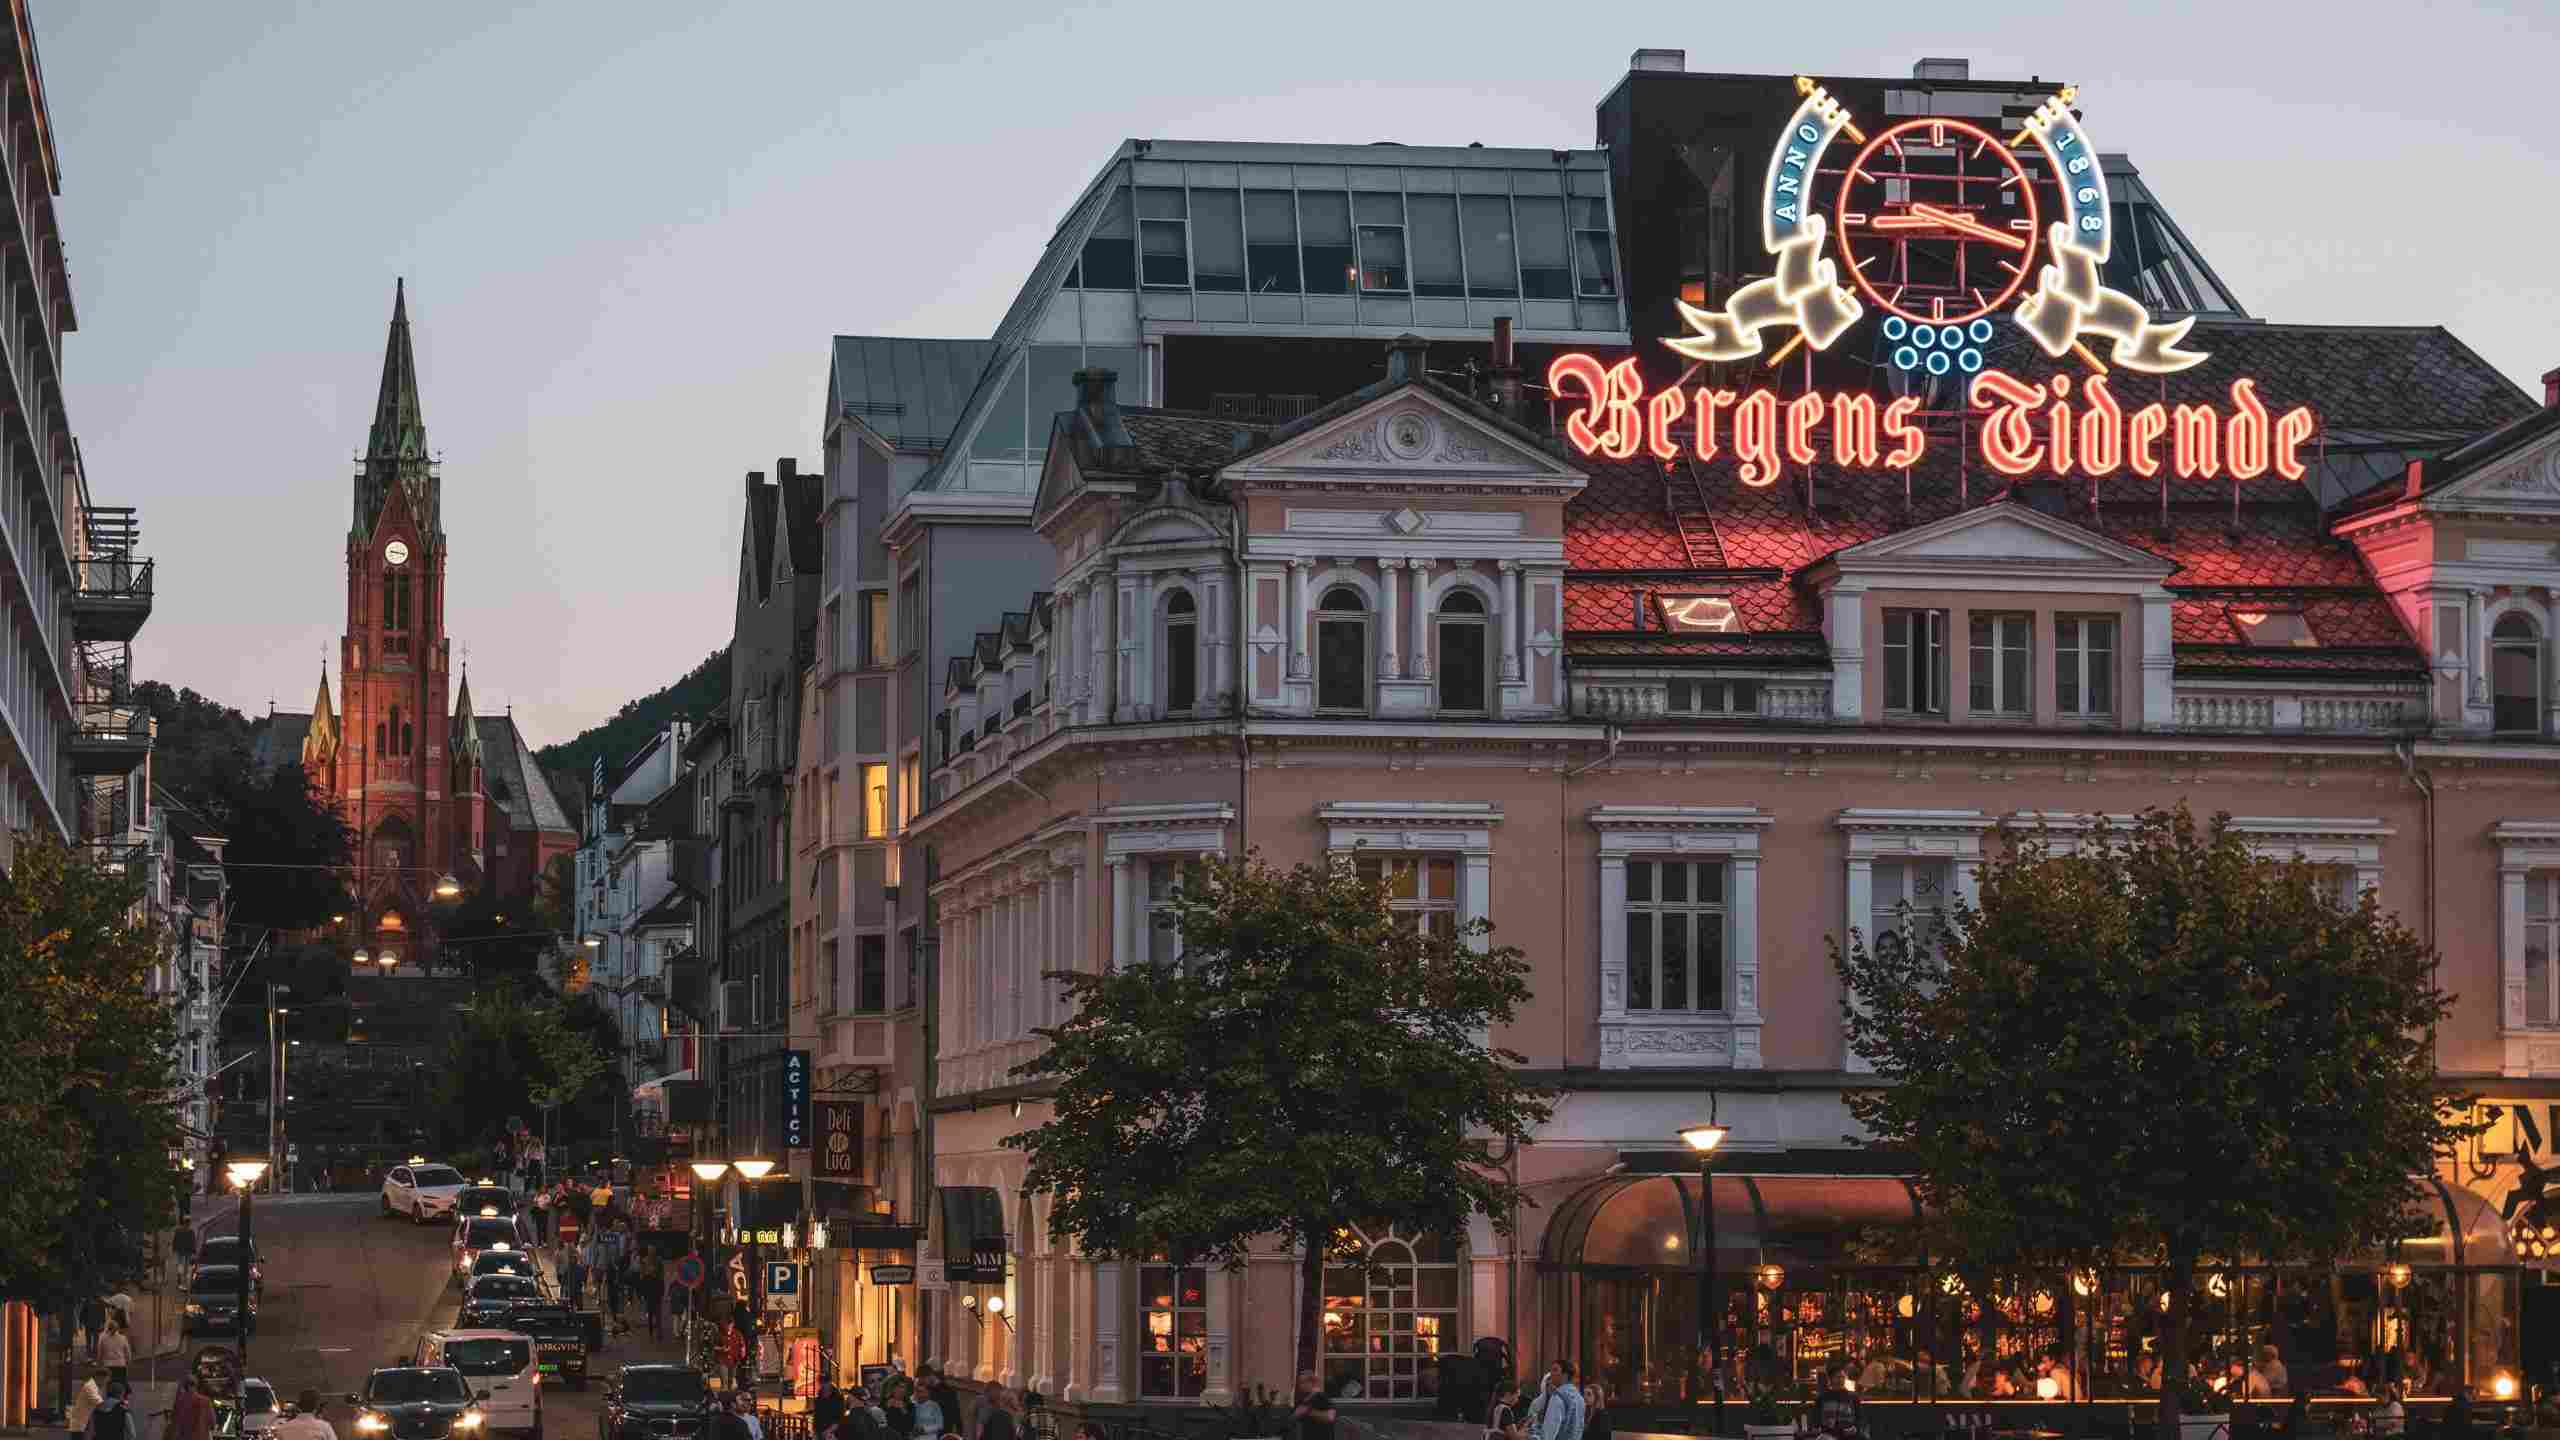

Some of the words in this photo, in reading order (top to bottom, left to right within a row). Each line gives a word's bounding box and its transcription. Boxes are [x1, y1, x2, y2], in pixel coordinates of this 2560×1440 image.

[1775, 124, 1819, 223] ANNO
[2055, 132, 2103, 232] 1868
[1547, 353, 1925, 488] Bergens
[1970, 371, 2316, 482] Tidende
[788, 1055, 801, 1145] ACTICO
[826, 1107, 852, 1131] Deli
[825, 1148, 851, 1170] Luca
[775, 1265, 792, 1290] P
